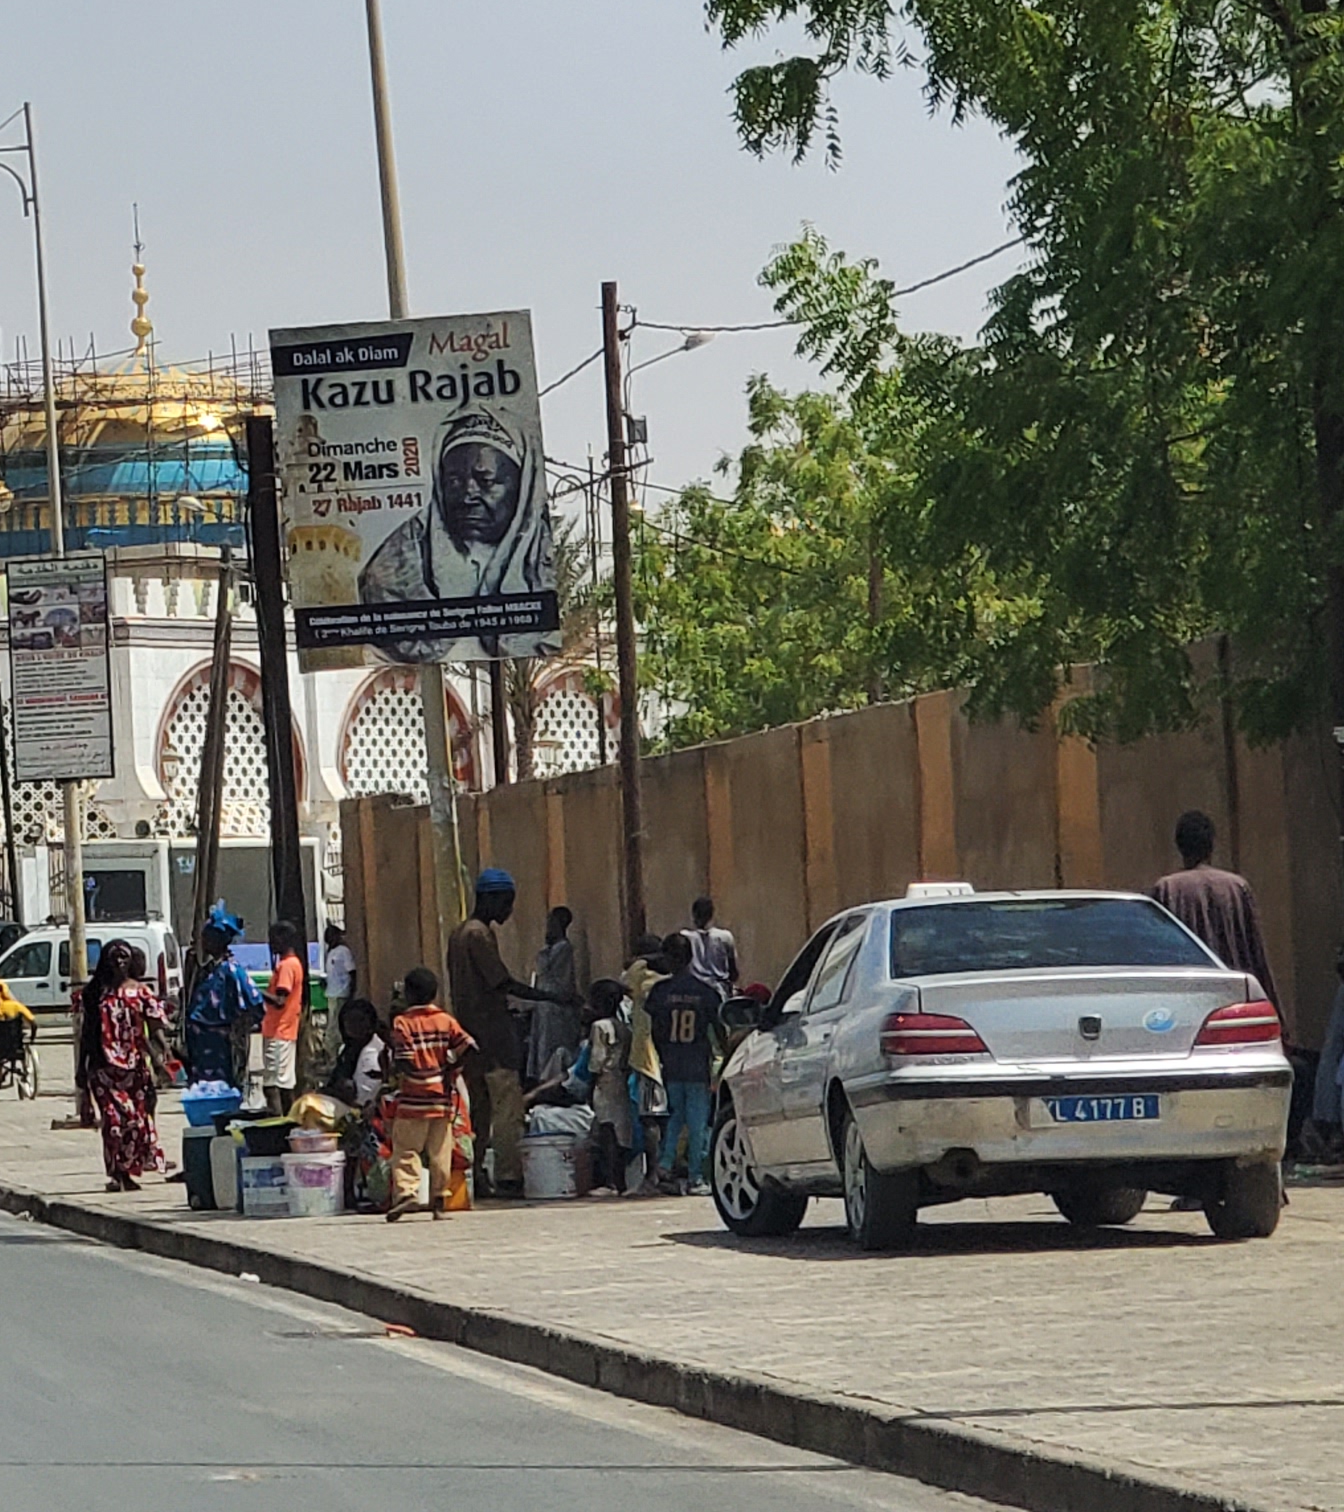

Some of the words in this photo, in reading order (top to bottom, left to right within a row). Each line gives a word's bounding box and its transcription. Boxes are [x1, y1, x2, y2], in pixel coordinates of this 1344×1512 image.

[429, 322, 510, 362] Magal
[293, 349, 331, 366] Dalal
[335, 347, 354, 363] ak
[358, 345, 399, 361] Diam
[301, 377, 395, 410] Kazu
[409, 359, 521, 409] Rajab
[308, 437, 397, 457] Dimanche
[402, 437, 420, 477] 2020
[309, 462, 337, 484] 22
[343, 460, 399, 481] Mars
[387, 492, 422, 508] 1441
[670, 1009, 696, 1042] 18
[1075, 1099, 1125, 1120] 4177
[1133, 1097, 1145, 1118] B
